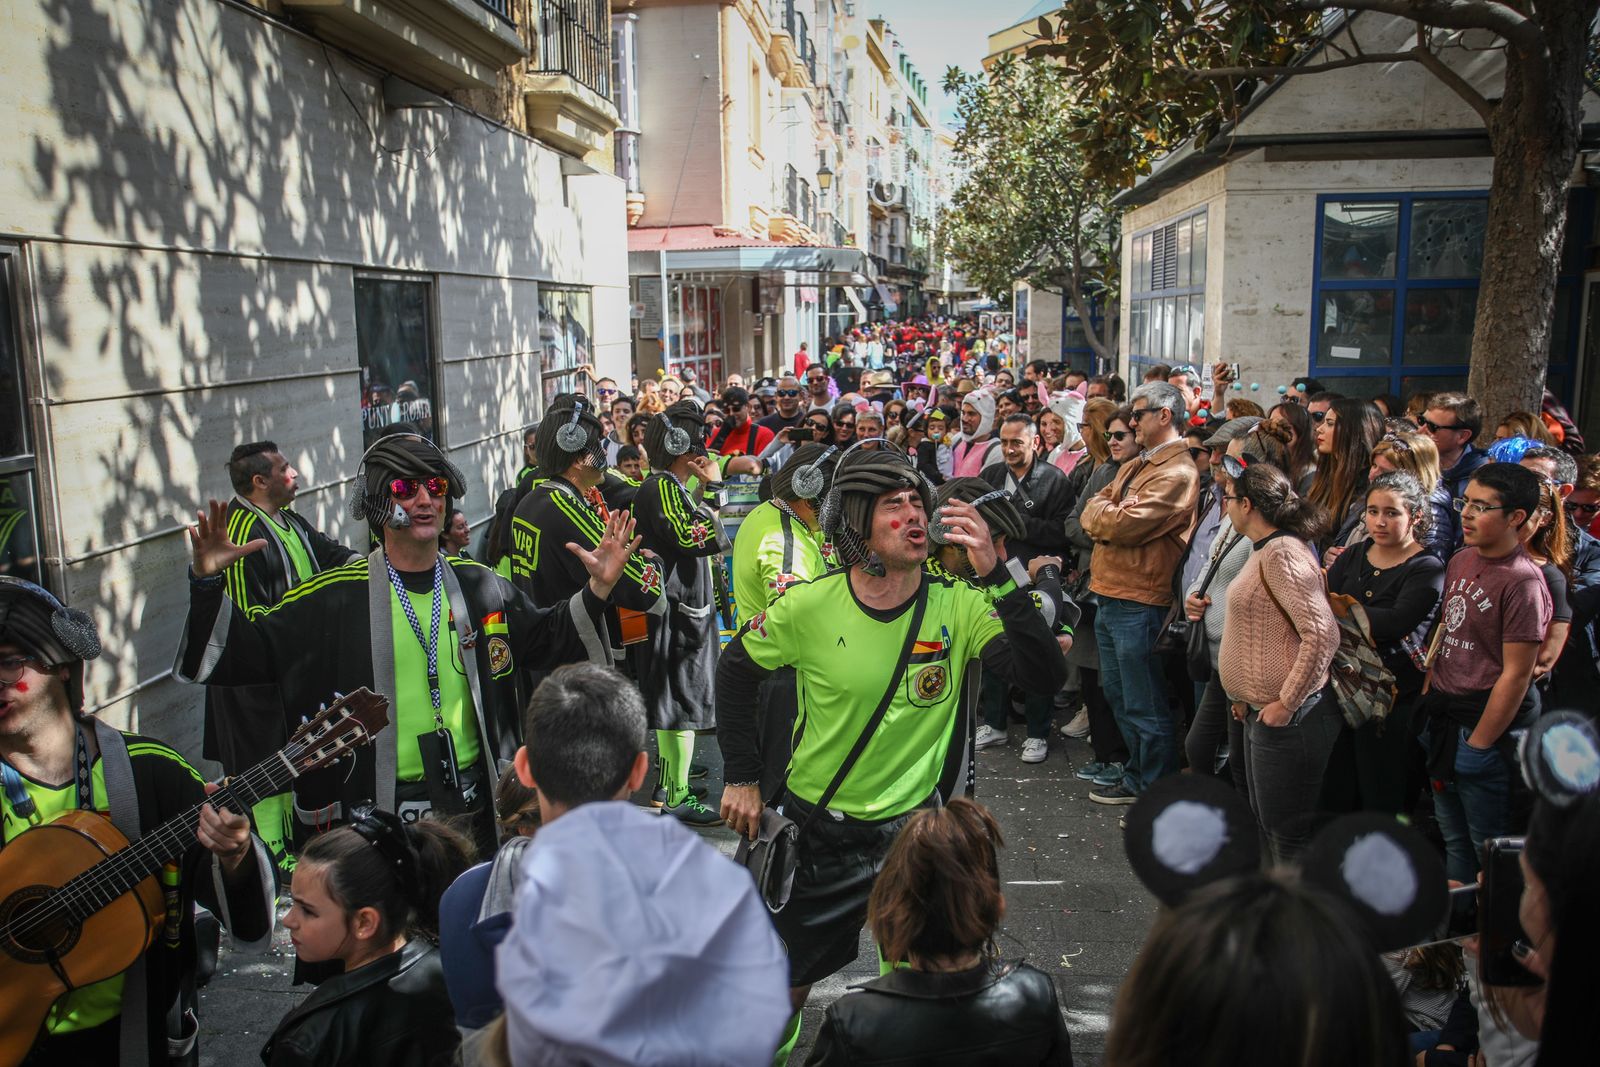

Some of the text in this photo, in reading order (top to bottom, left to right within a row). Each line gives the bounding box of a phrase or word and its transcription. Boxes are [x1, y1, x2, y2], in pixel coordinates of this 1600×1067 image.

[403, 398, 431, 423] ROMA
[513, 528, 533, 558] VAR
[1446, 578, 1493, 613] ARLEM
